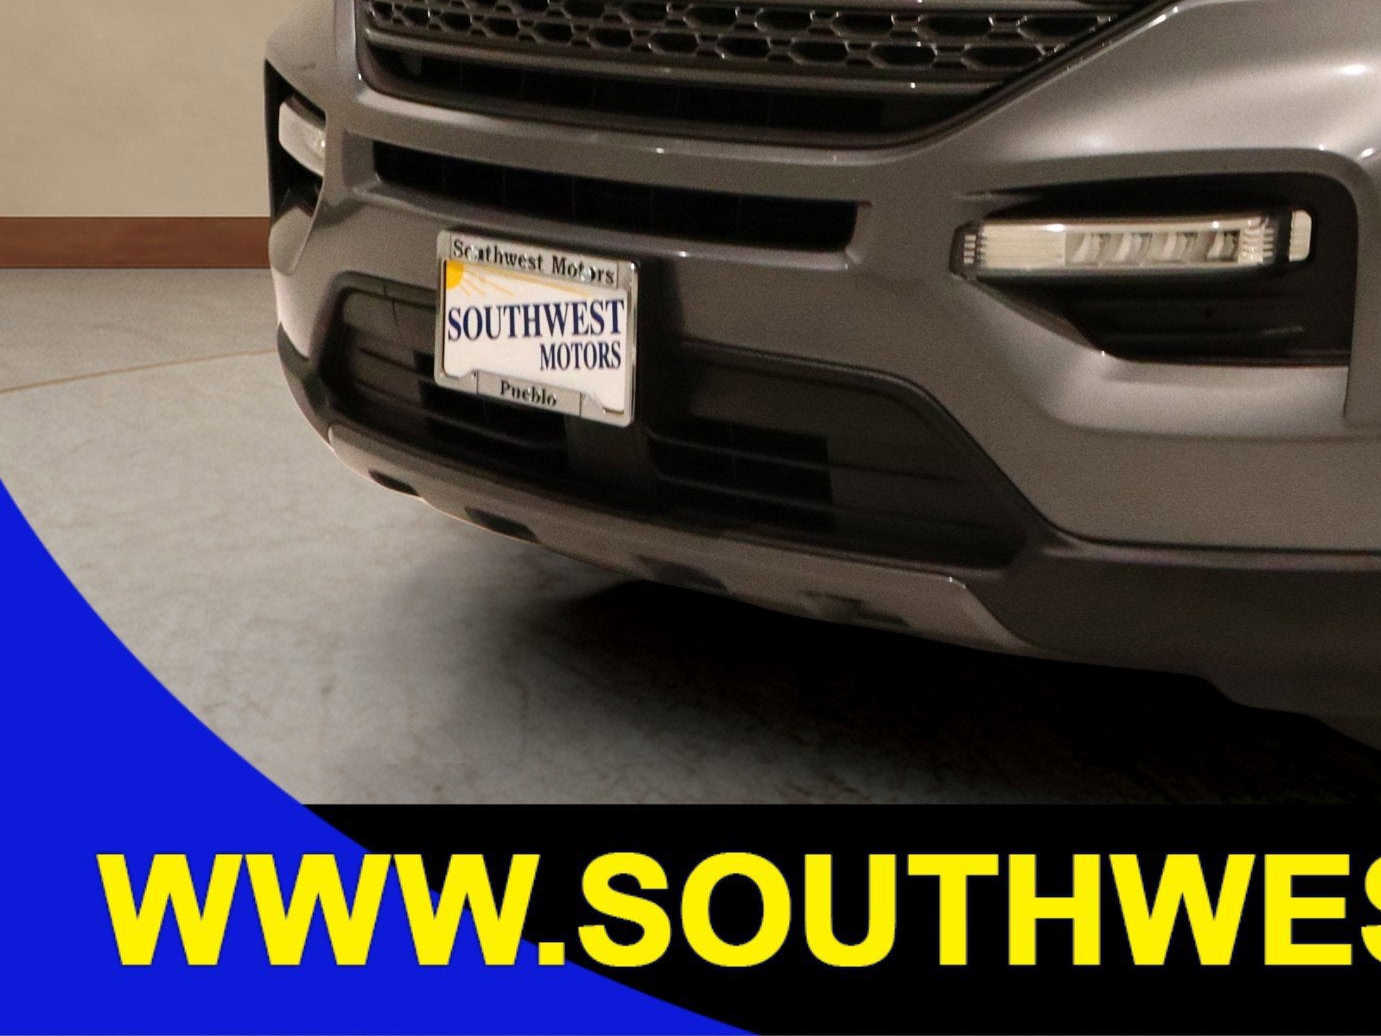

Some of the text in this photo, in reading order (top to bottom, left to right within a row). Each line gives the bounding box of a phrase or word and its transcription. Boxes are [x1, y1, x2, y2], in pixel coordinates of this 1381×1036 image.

[447, 299, 625, 342] SOUTHWEST
[540, 340, 622, 372] MOTORS
[500, 379, 558, 407] Pueblo
